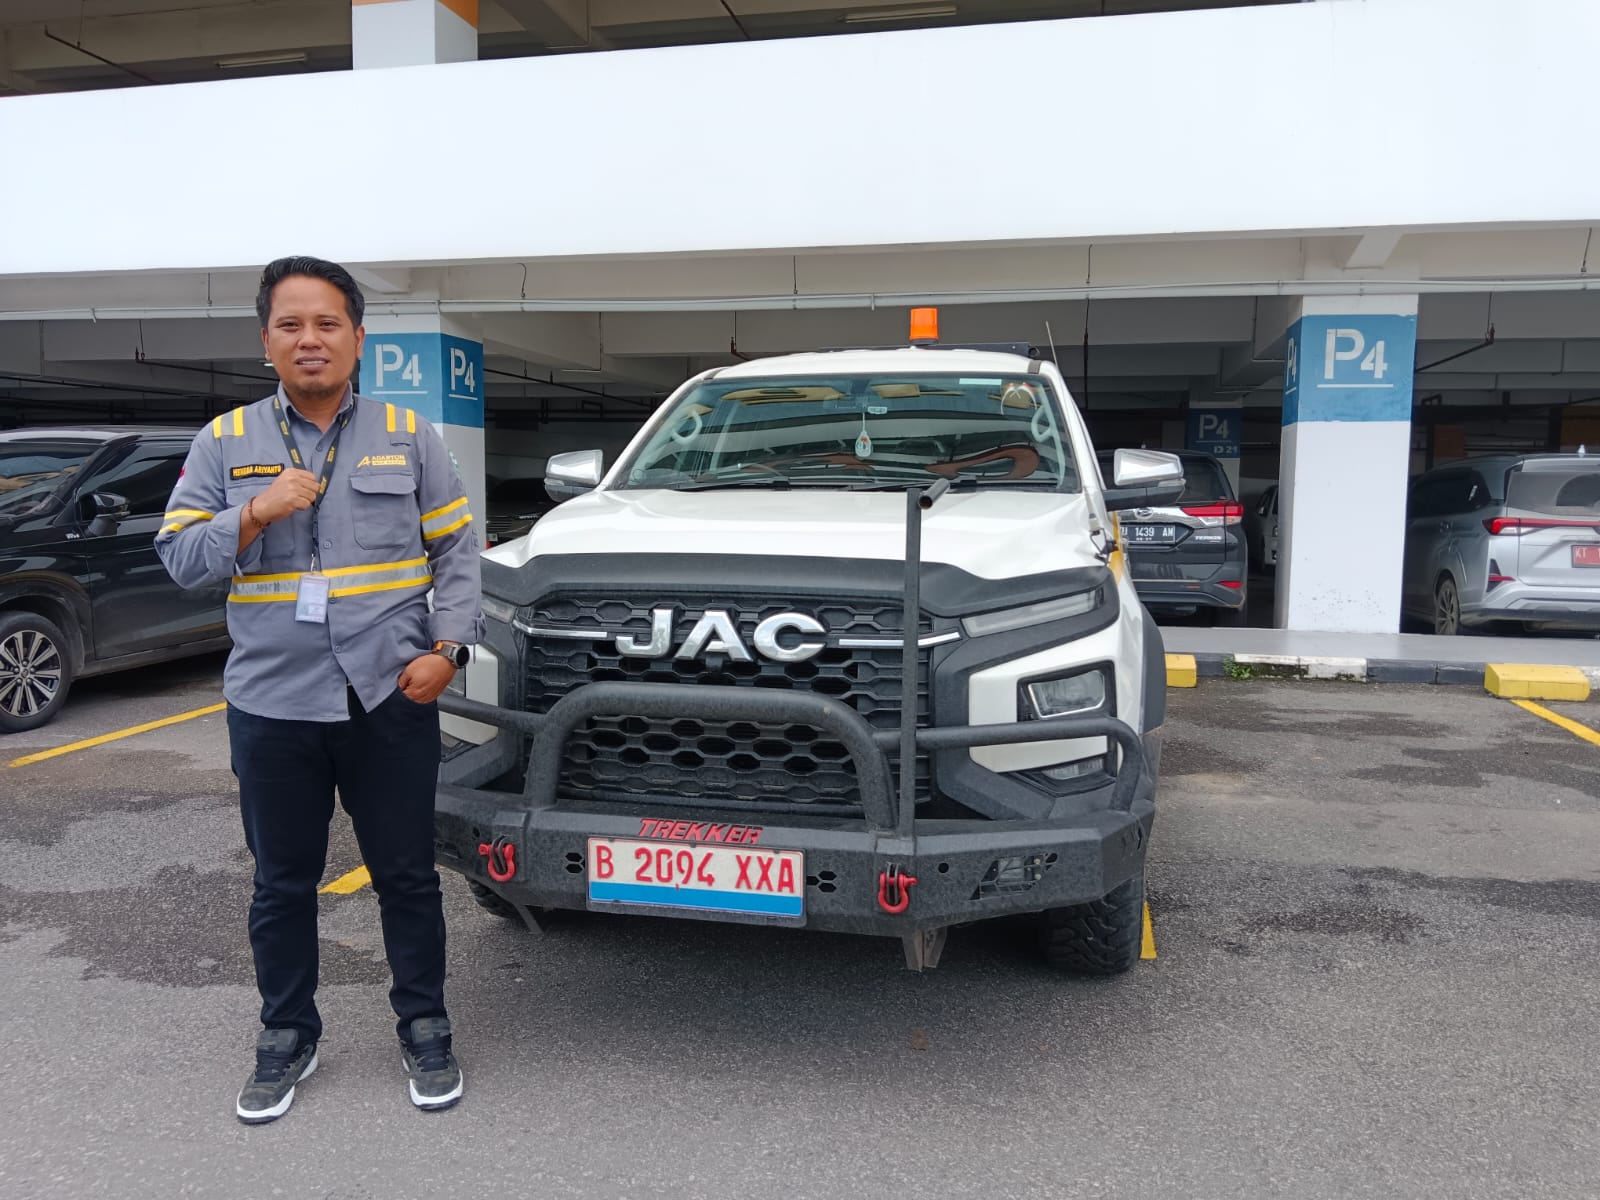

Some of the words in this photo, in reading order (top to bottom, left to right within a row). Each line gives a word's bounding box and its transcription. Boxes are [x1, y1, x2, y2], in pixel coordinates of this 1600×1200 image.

[375, 343, 422, 388] P4
[450, 347, 475, 393] P4
[1286, 337, 1297, 387] P4
[1324, 328, 1388, 379] P4
[1199, 414, 1229, 439] P4
[1135, 527, 1155, 537] 1439
[1162, 527, 1174, 537] AM
[615, 608, 827, 663] JAC
[638, 817, 763, 845] TREKKER
[595, 844, 615, 880] B
[634, 847, 716, 887] 2094
[735, 853, 795, 894] XXA
